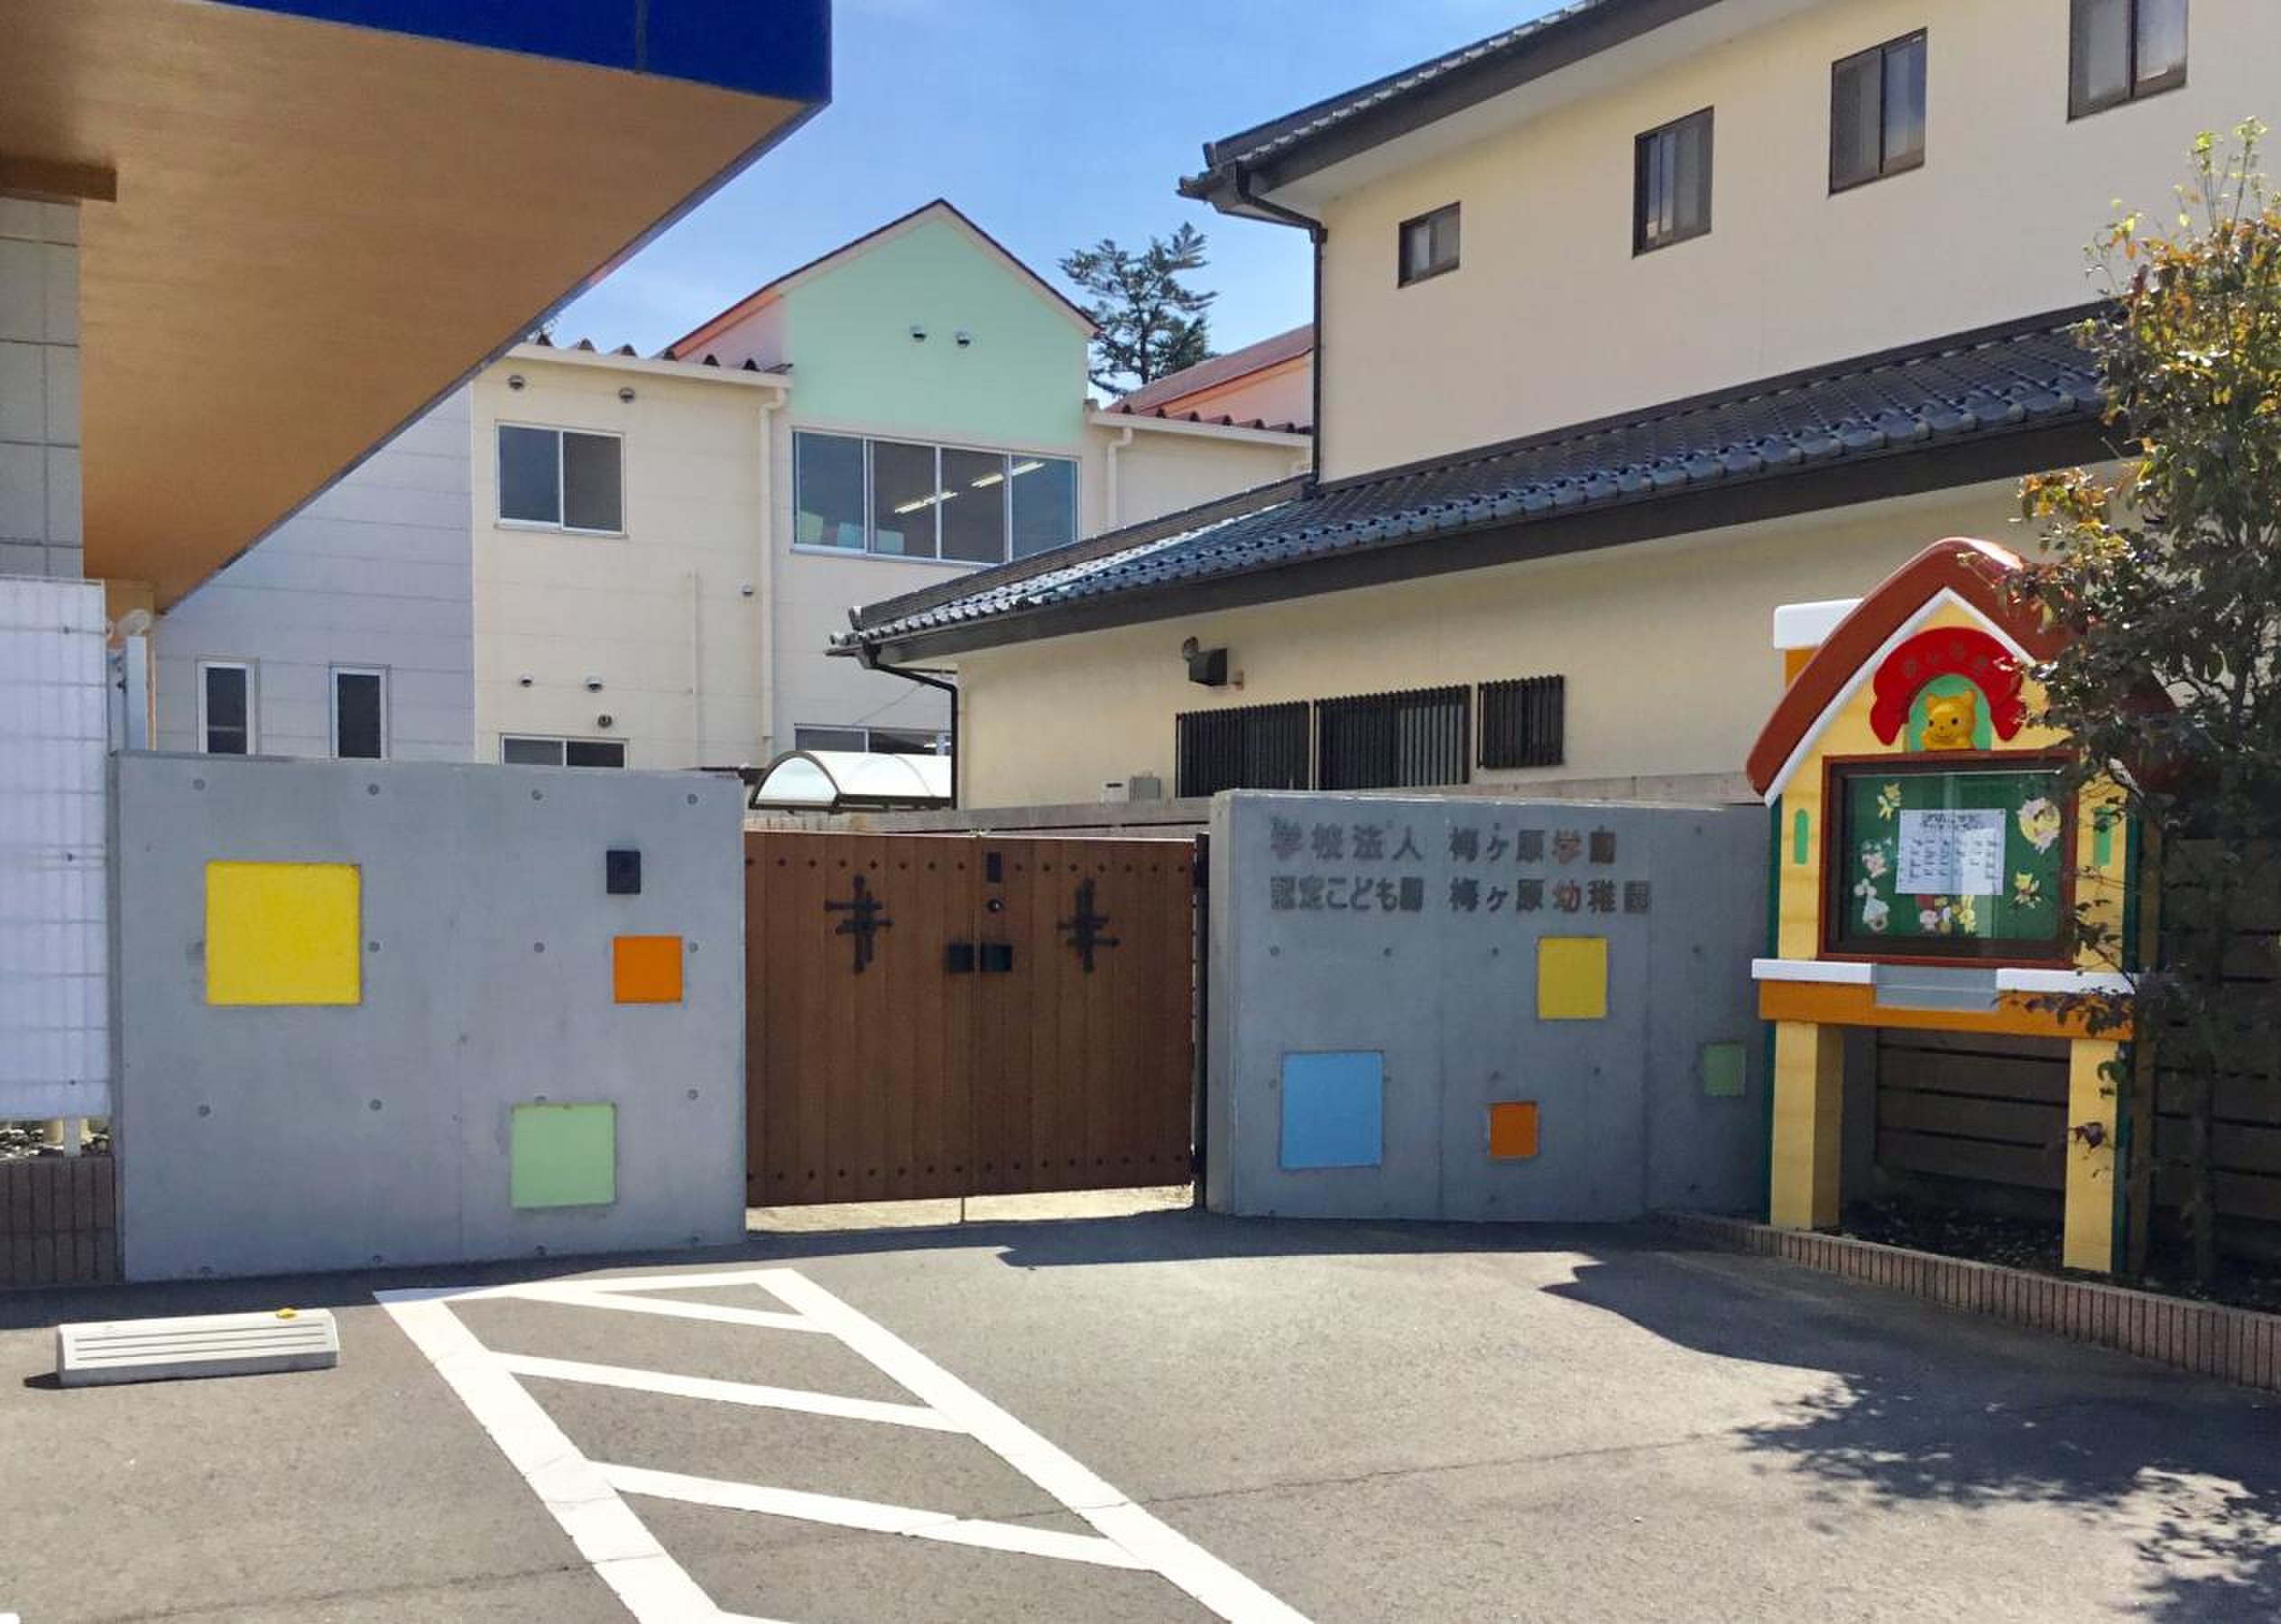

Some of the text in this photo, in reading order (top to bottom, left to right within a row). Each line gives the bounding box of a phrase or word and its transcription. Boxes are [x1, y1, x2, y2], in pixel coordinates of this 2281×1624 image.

[1270, 820, 1423, 862] 学校法人
[1270, 876, 1423, 911] 認定こども園
